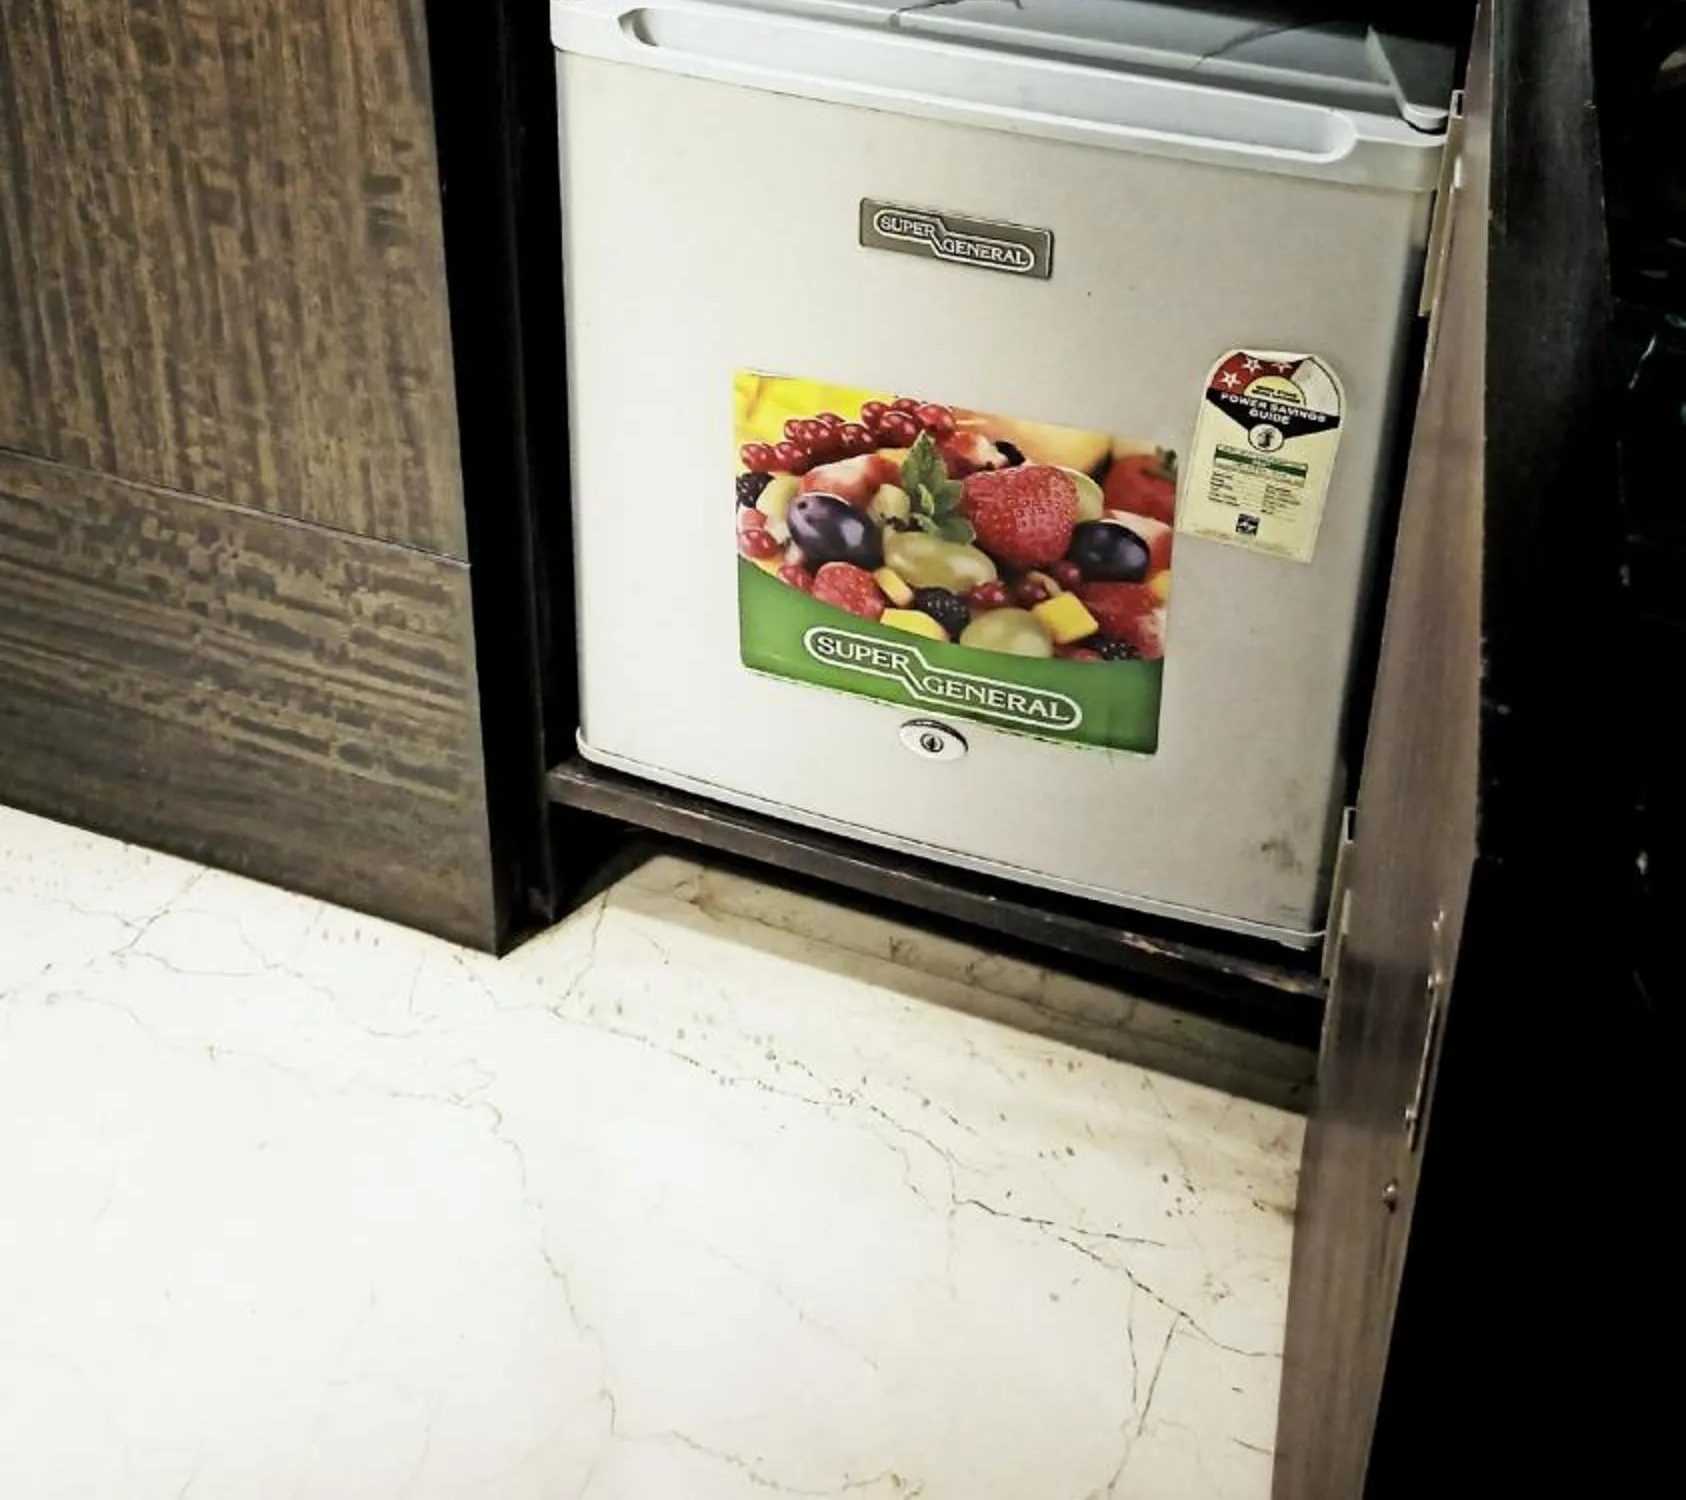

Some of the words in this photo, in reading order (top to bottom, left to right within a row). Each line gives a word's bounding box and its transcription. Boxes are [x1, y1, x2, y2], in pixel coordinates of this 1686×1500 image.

[881, 214, 936, 238] SUPER
[942, 238, 1029, 266] GENERAL
[1220, 392, 1268, 410] POWER
[1270, 403, 1327, 423] SAVINGS
[1248, 408, 1291, 425] GUIDE
[817, 635, 910, 672] SUPER
[922, 676, 1071, 722] GENERAL
